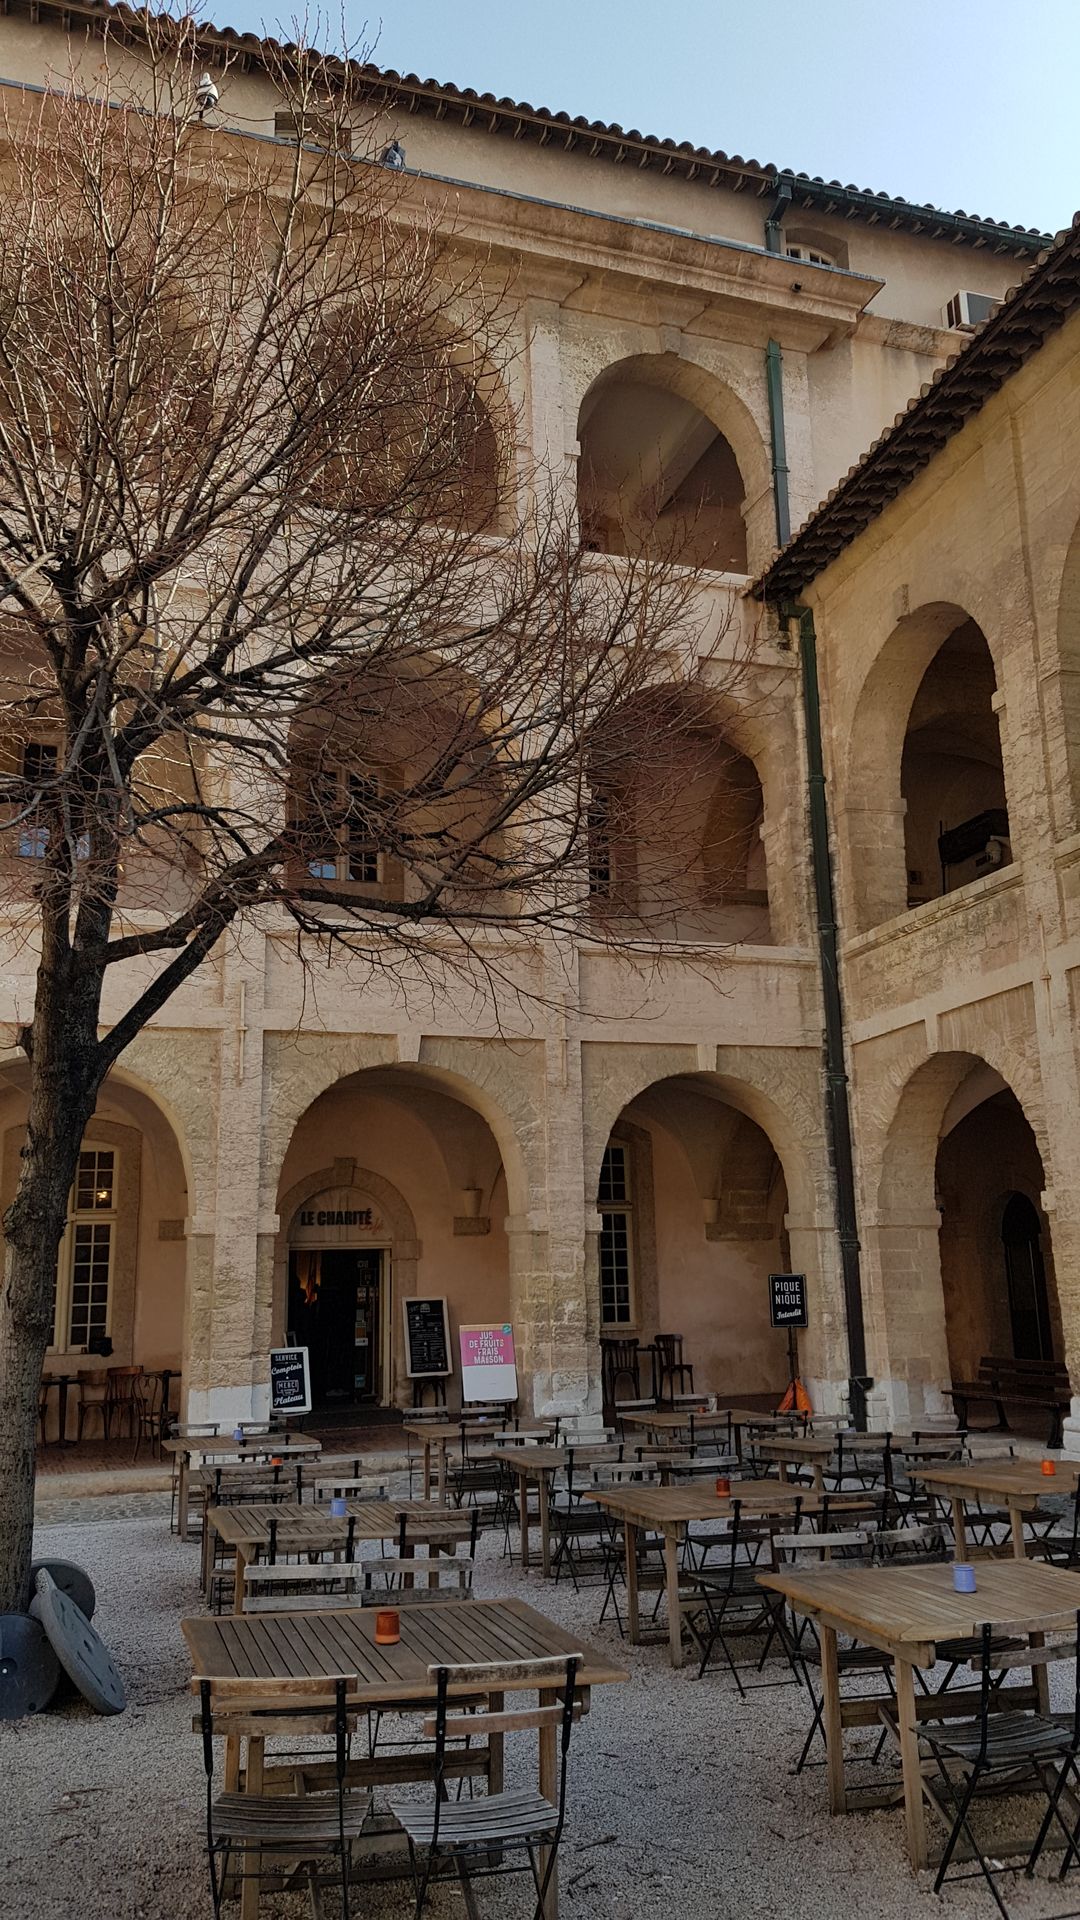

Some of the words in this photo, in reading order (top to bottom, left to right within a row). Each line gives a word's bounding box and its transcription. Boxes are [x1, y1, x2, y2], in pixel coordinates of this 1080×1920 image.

[300, 1211, 314, 1226] LE
[317, 1208, 372, 1226] CHARITÉ
[775, 1282, 800, 1292] PIQUE
[775, 1294, 801, 1304] NIQUE
[776, 1309, 802, 1320] Interdit
[479, 1331, 493, 1340] JUS
[469, 1340, 478, 1348] DE
[480, 1339, 504, 1348] FRUITS
[478, 1347, 499, 1355] FRAIS
[474, 1355, 504, 1364] MAISON
[273, 1394, 304, 1406] Plateau
